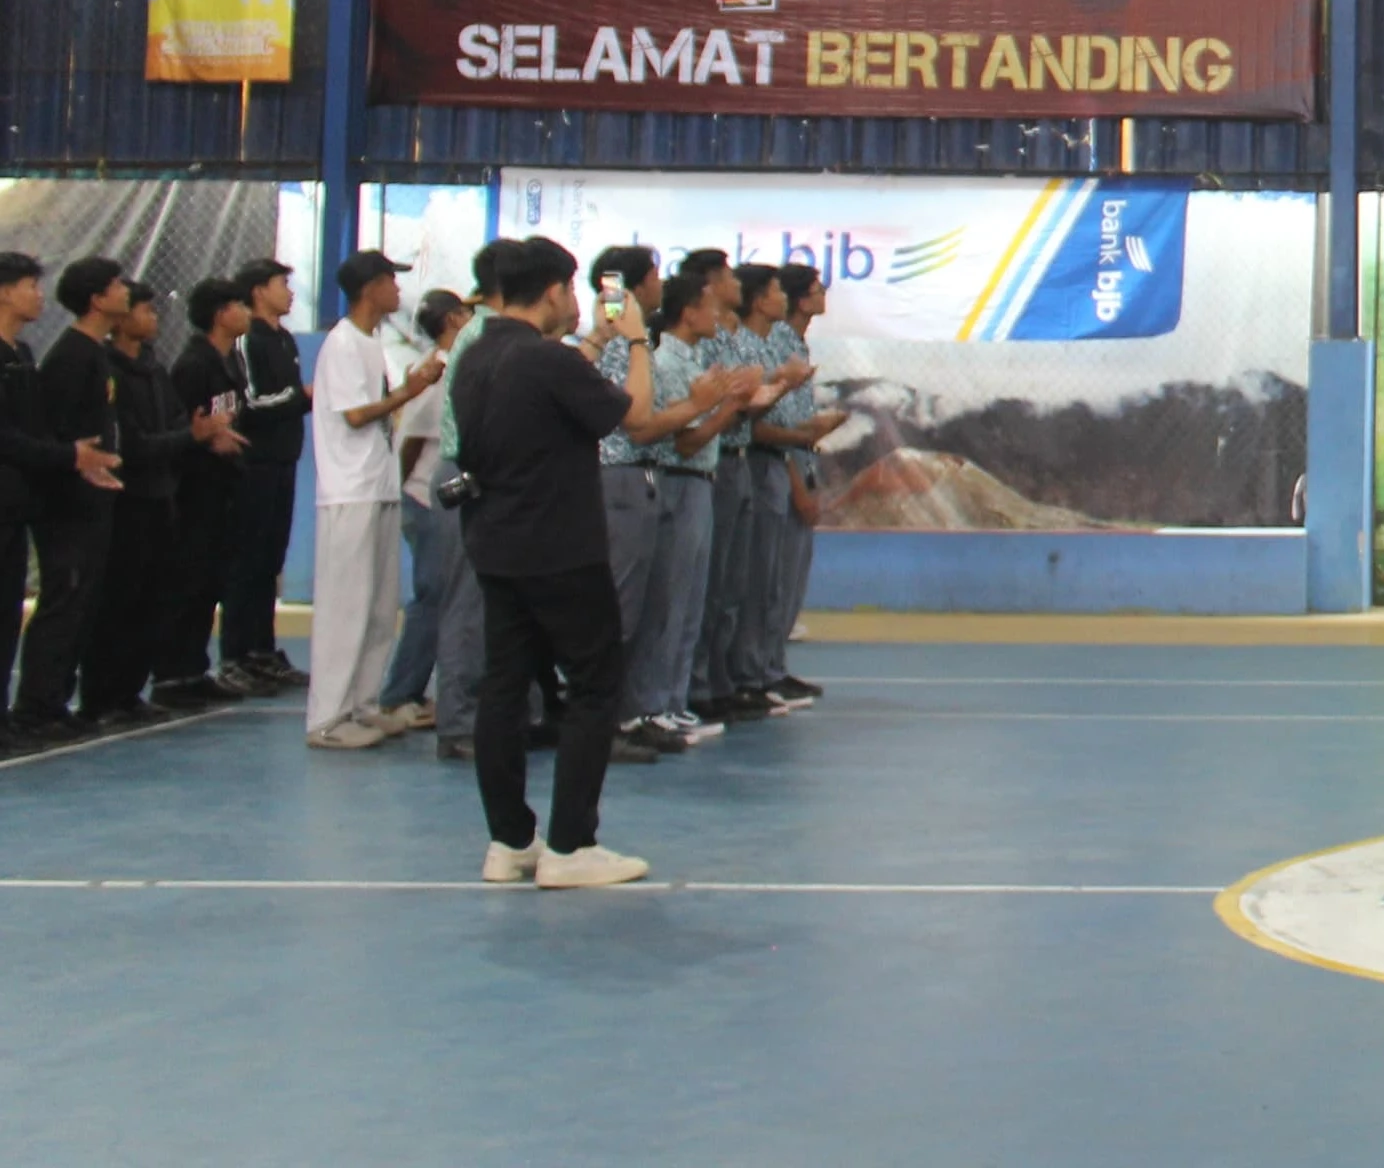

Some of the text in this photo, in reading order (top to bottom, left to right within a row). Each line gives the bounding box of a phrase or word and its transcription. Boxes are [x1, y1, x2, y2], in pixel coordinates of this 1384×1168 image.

[456, 23, 1233, 94] SELAMAT BERTANDING
[782, 230, 875, 290] bjb
[1091, 199, 1127, 322] bank bjb
